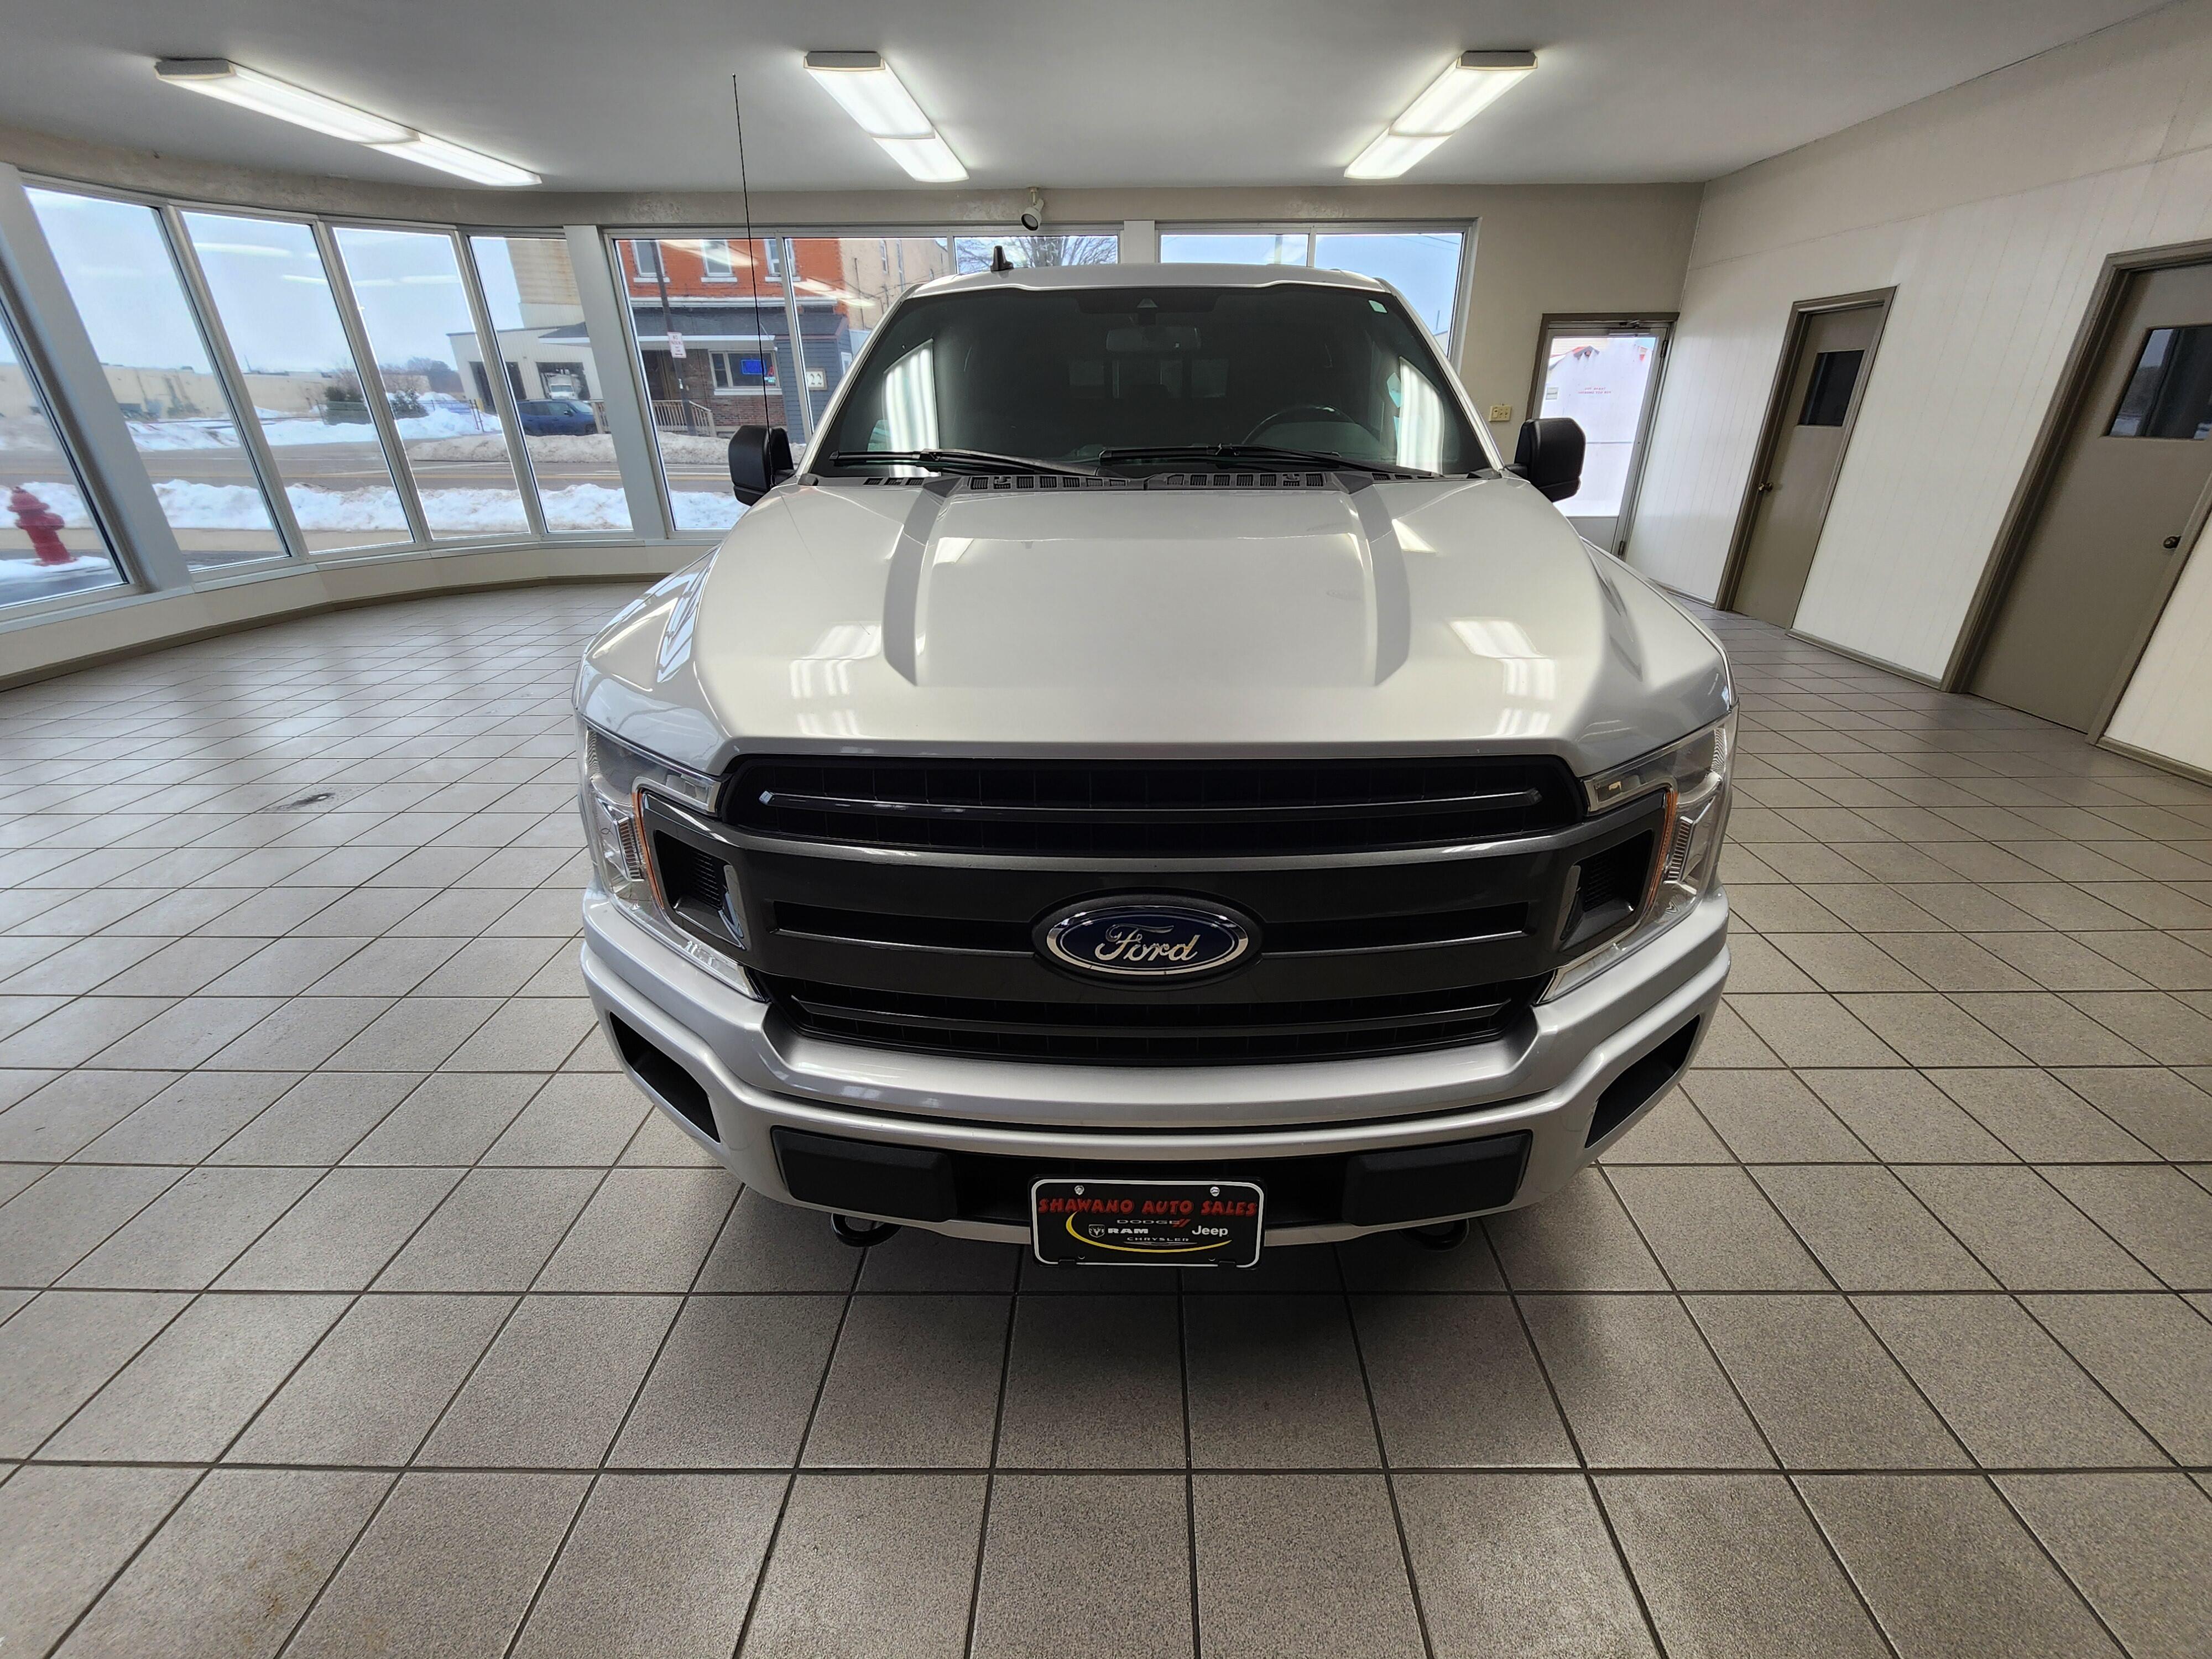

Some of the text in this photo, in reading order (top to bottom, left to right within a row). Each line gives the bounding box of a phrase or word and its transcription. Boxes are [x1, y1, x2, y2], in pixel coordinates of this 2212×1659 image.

[1094, 924, 1201, 962] Ford
[1038, 1198, 1258, 1216] SHAWANO AUTO SALES
[1192, 1225, 1228, 1237] Jeep
